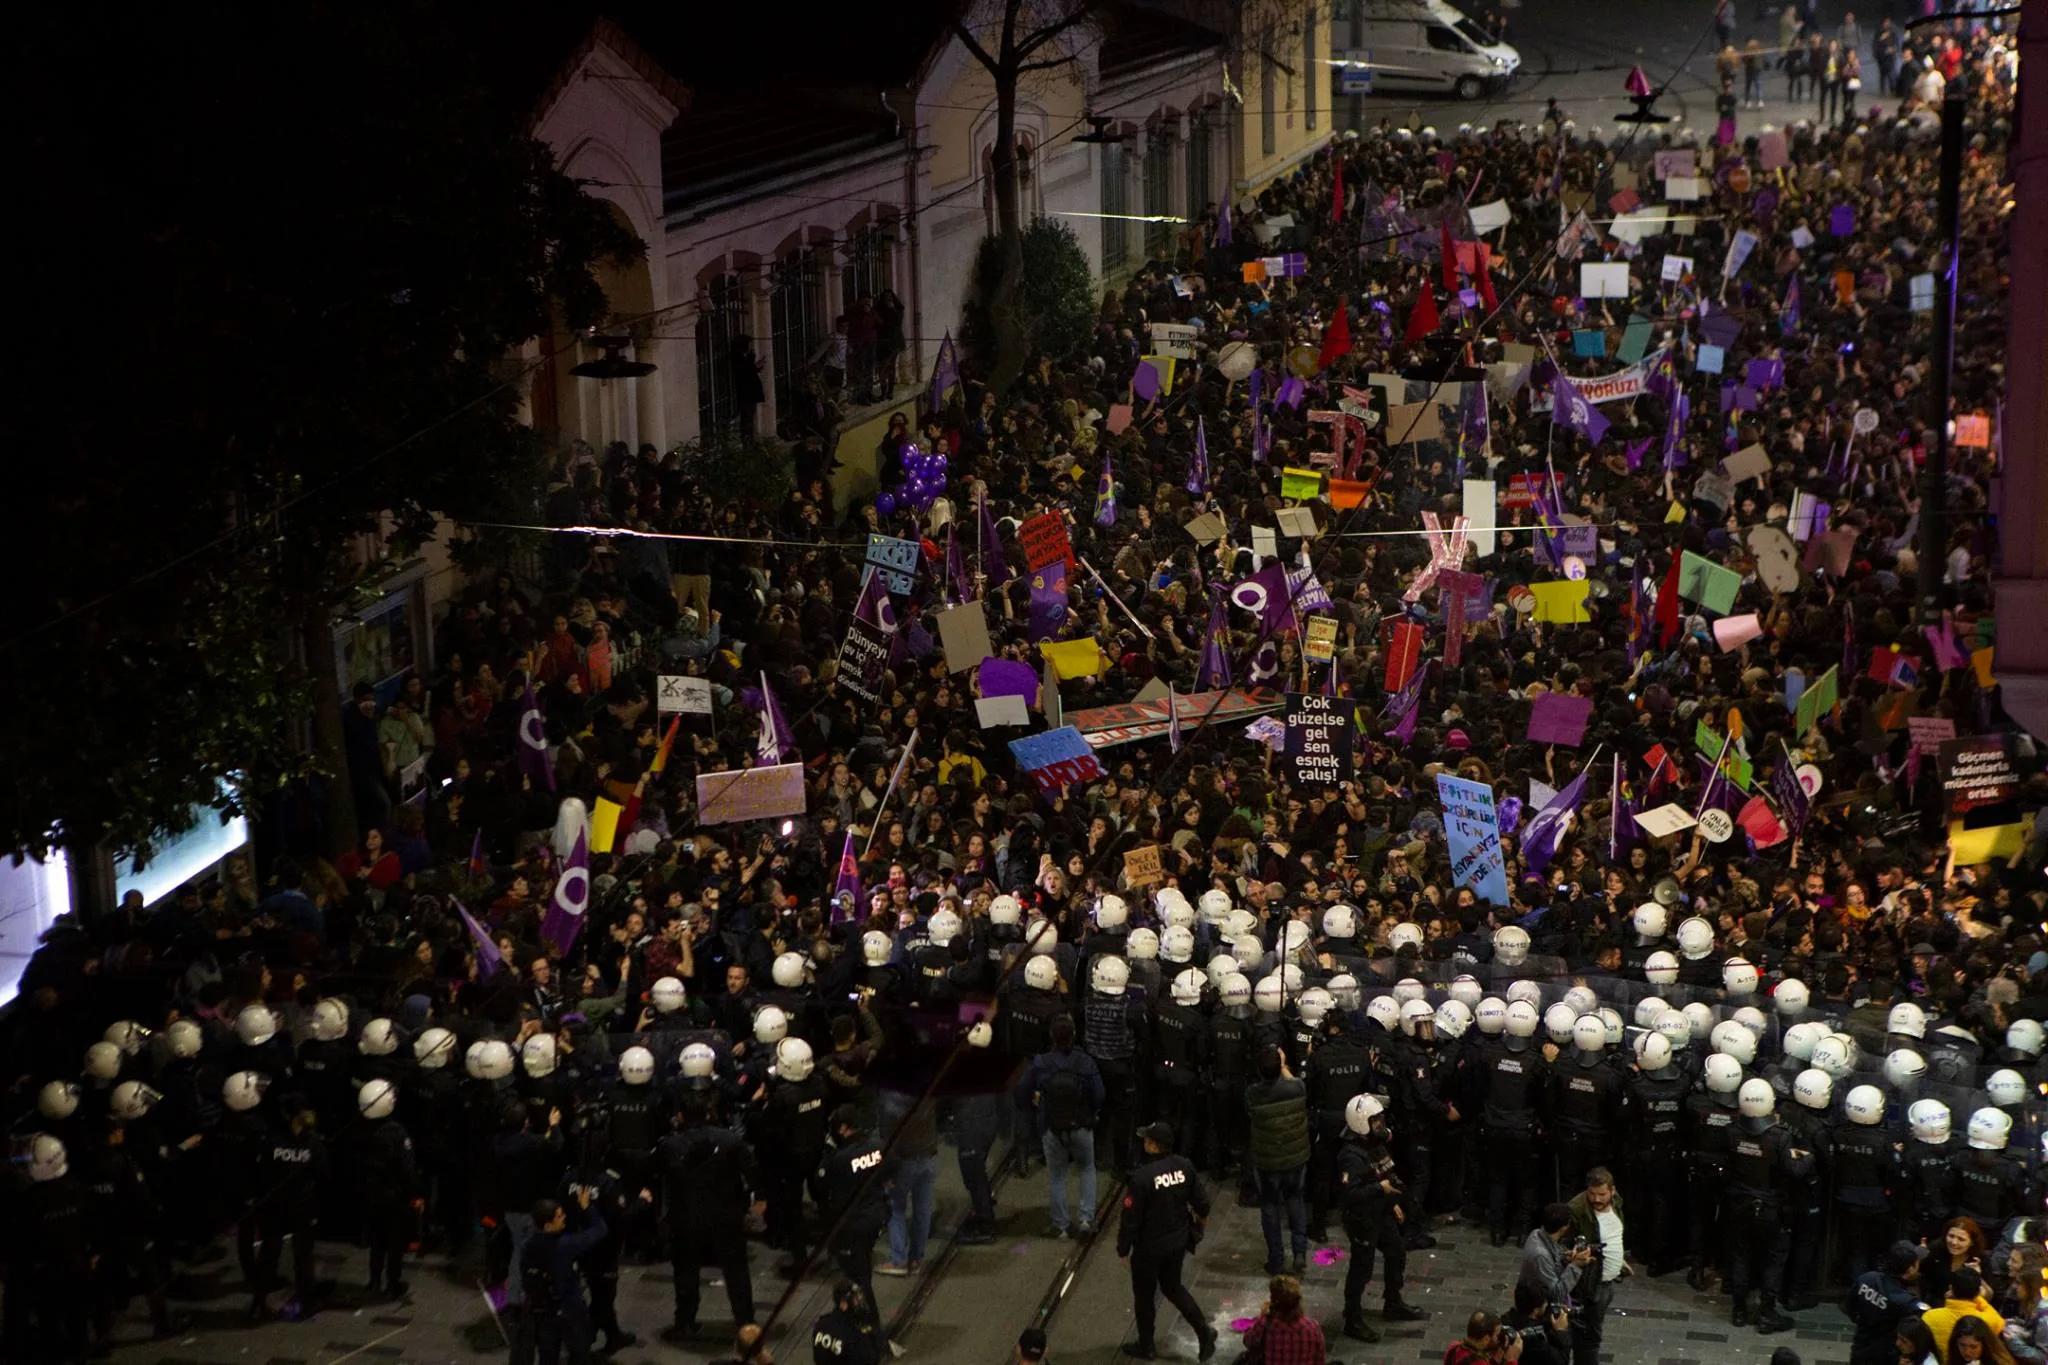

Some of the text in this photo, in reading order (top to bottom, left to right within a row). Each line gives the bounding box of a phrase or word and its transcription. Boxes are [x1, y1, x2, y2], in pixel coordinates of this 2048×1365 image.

[1302, 695, 1331, 712] Çok
[1287, 711, 1346, 727] güzelse
[1304, 726, 1329, 741] gel
[1303, 742, 1331, 753] sen
[1295, 754, 1340, 768] esnek
[1298, 767, 1337, 785] çalış!
